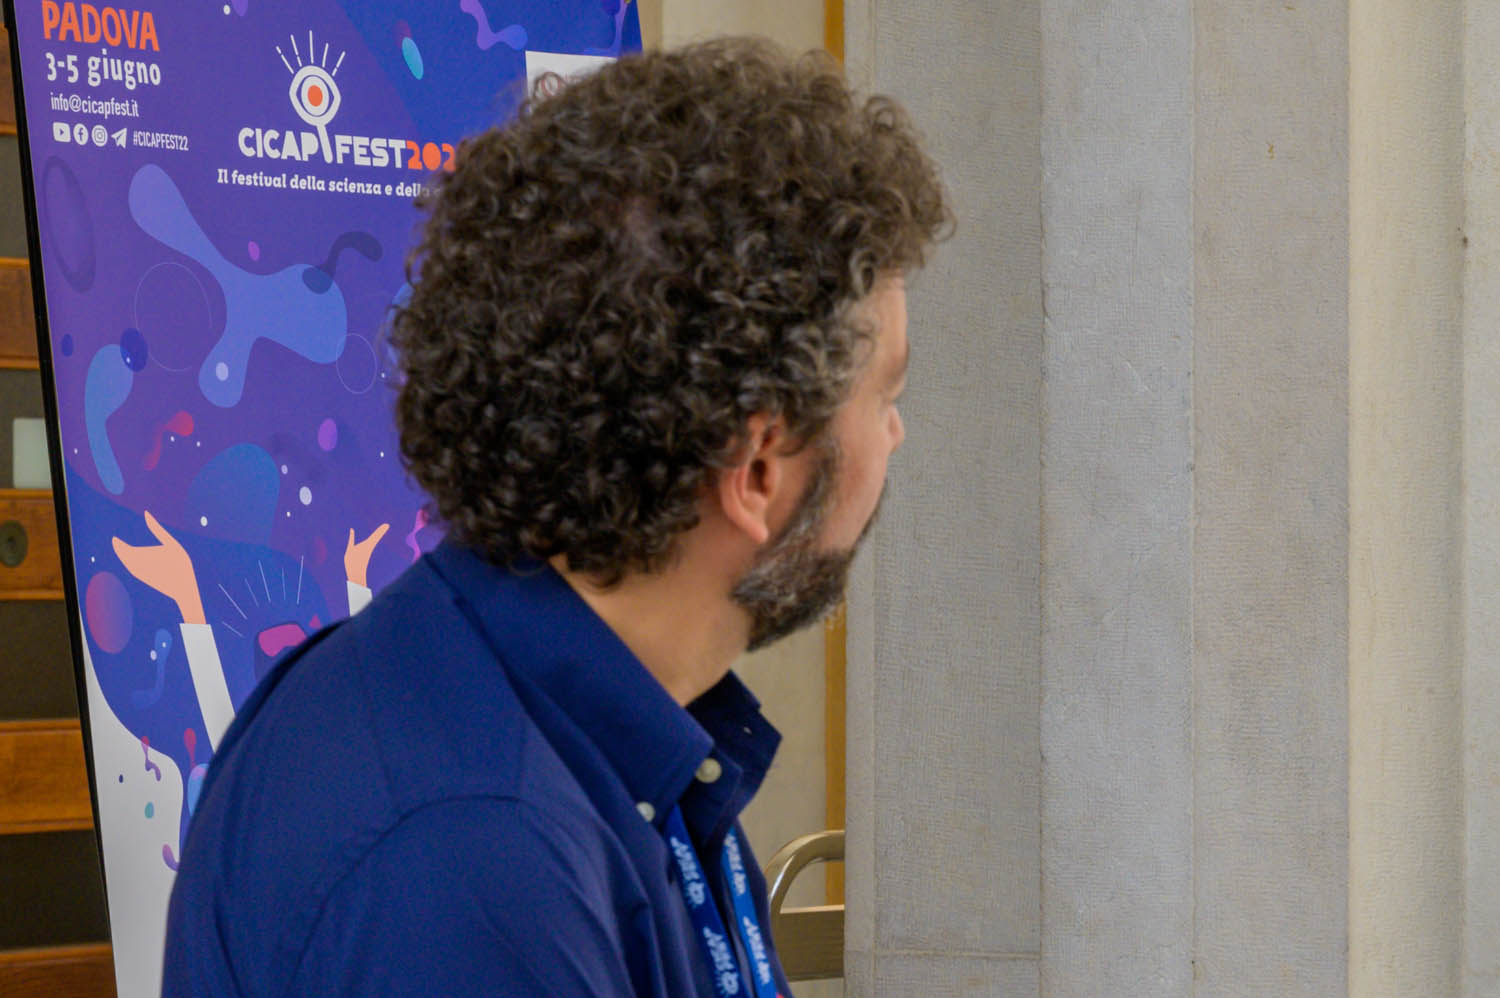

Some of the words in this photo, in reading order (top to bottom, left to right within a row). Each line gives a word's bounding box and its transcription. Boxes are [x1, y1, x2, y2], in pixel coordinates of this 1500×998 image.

[42, 0, 160, 51] PADOVA
[45, 52, 79, 83] 3-5
[88, 48, 161, 90] giugno
[50, 92, 139, 119] info@cicapfest.it
[133, 131, 189, 151] #CICAPFEST22
[334, 134, 456, 172] FEST202
[217, 168, 229, 184] Il
[231, 169, 287, 188] festival
[290, 175, 326, 191] della
[328, 178, 382, 196] scienza
[384, 186, 393, 196] e
